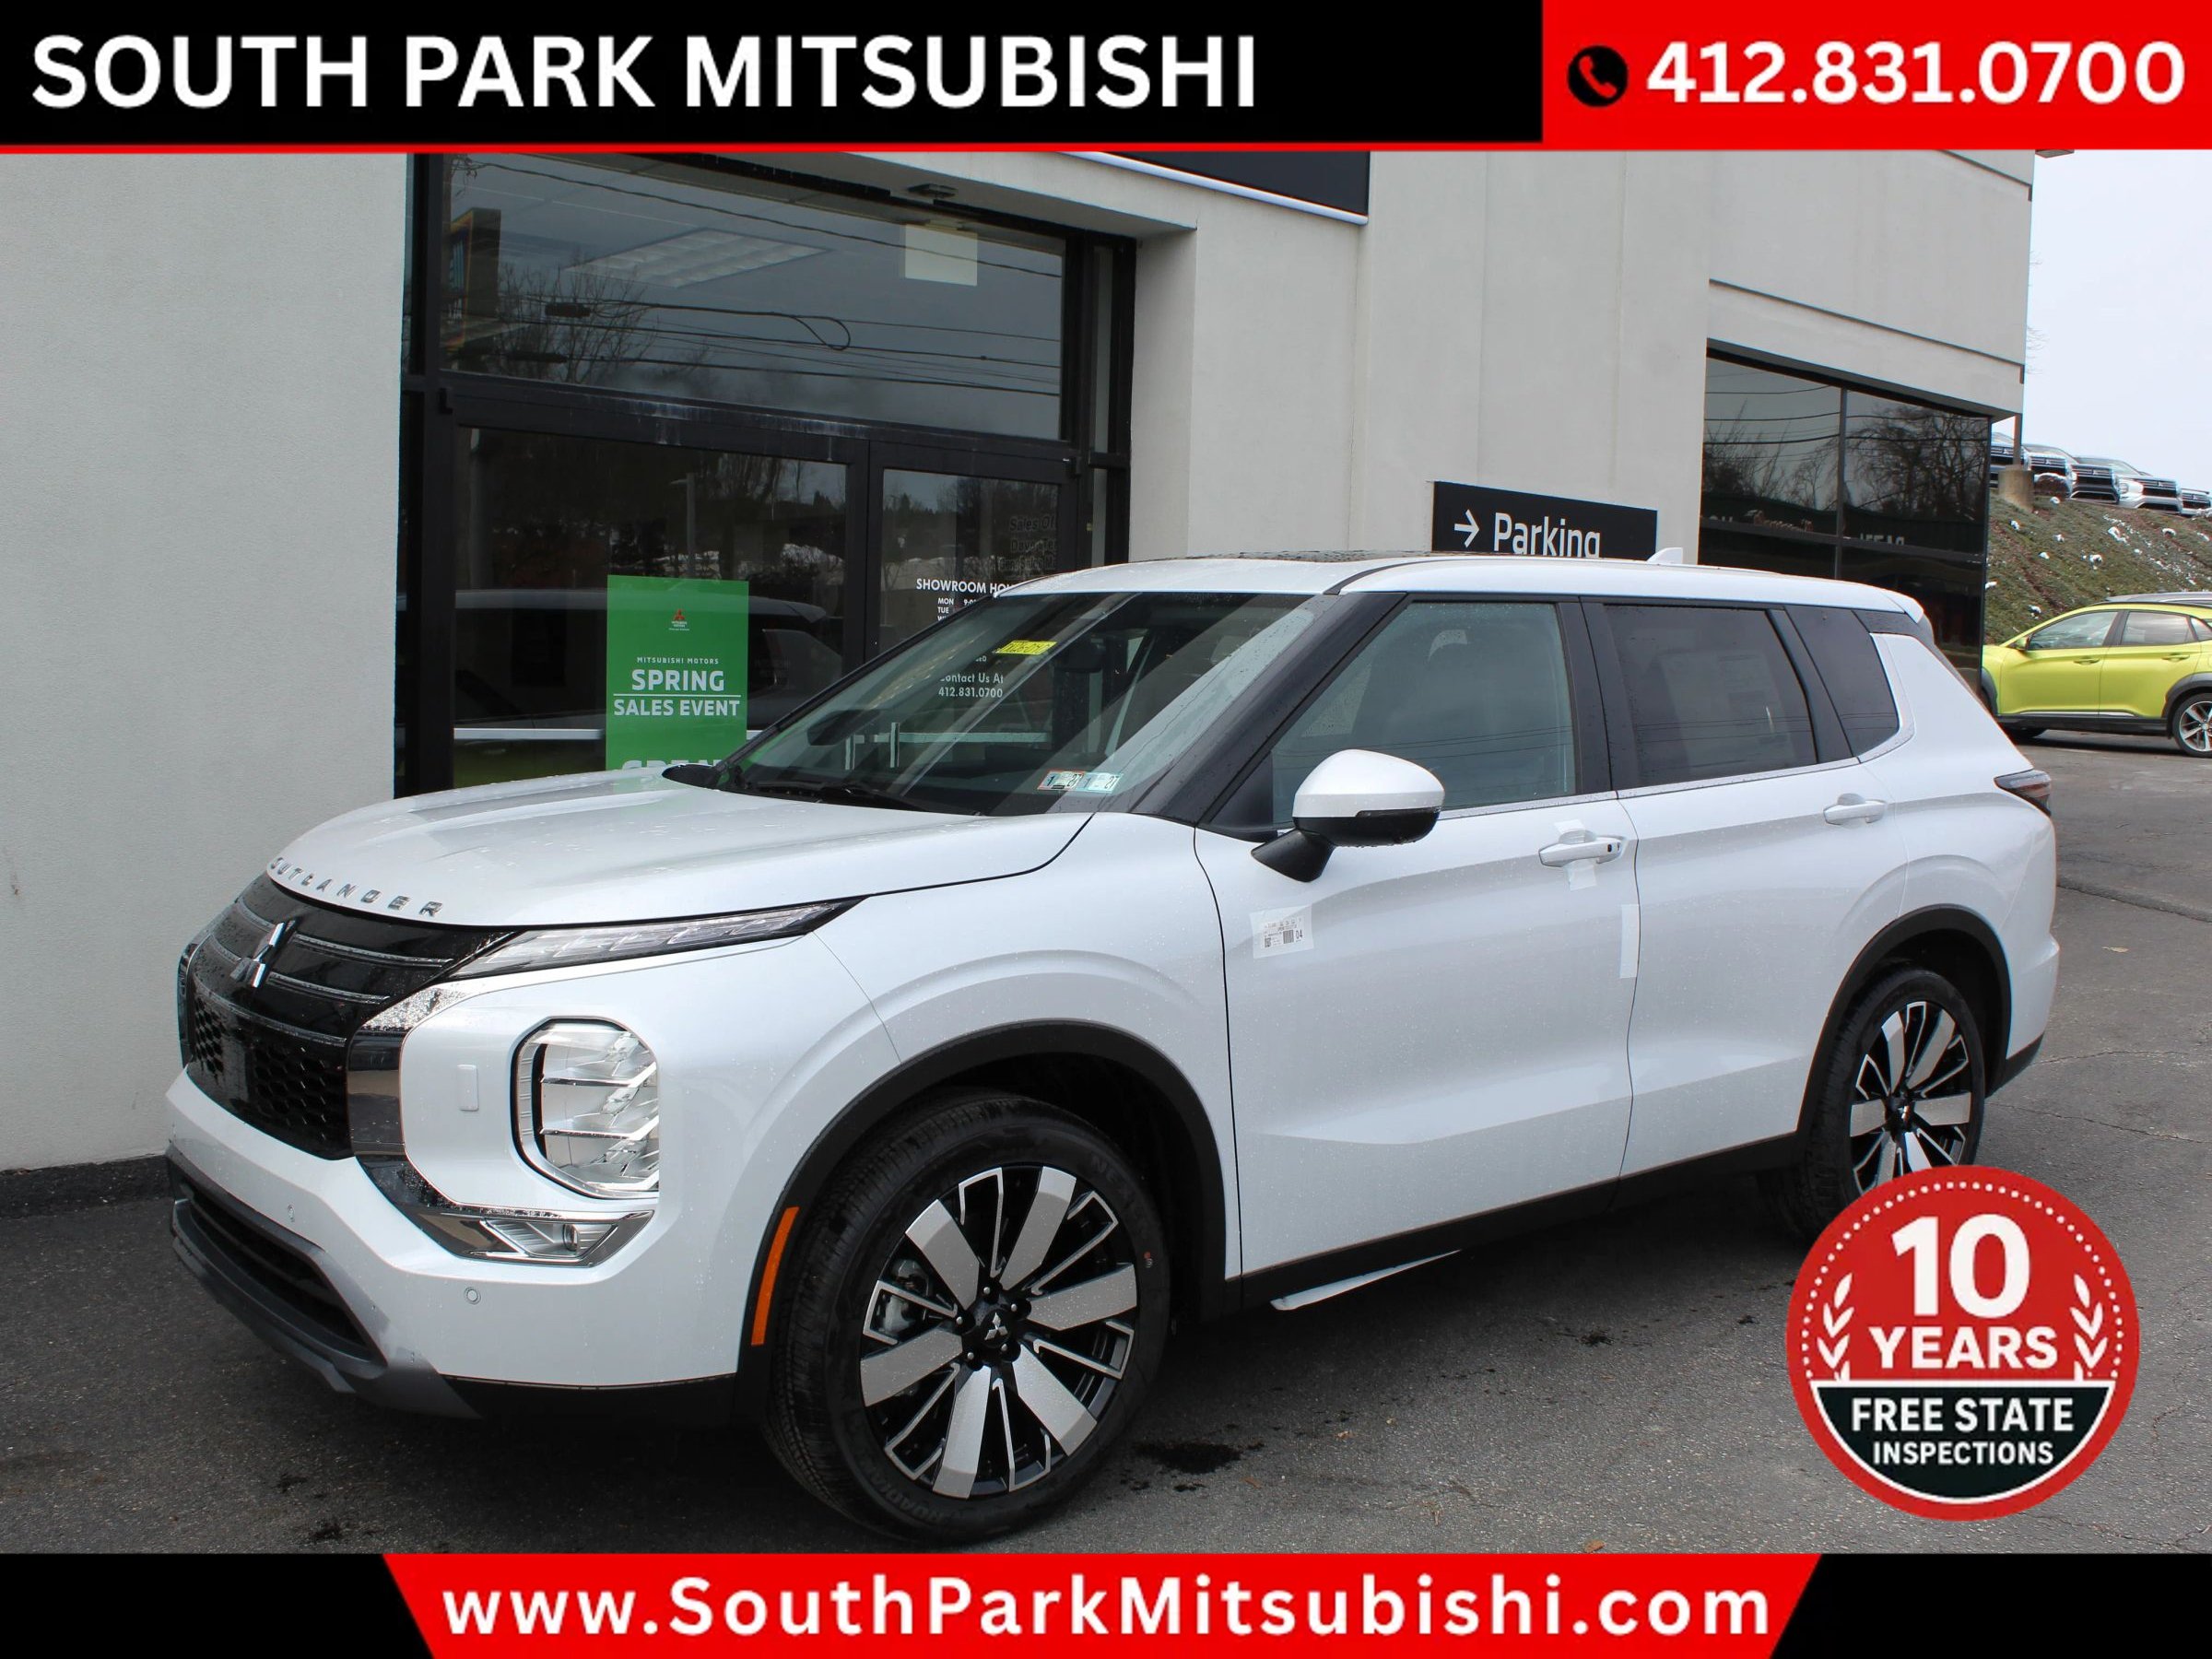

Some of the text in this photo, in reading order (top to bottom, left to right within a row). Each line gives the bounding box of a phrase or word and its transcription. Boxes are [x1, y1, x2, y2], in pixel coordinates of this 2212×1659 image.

[1493, 512, 1601, 559] Parking
[916, 578, 987, 594] SHOWROOM
[937, 597, 954, 606] MON
[637, 656, 684, 665] MITSUBISHI
[631, 668, 724, 692] SPRING
[978, 672, 990, 684] Us
[938, 686, 1004, 698] 412.831.0700
[613, 699, 740, 716] SALES EVENT
[270, 856, 444, 918] OUTLANDER
